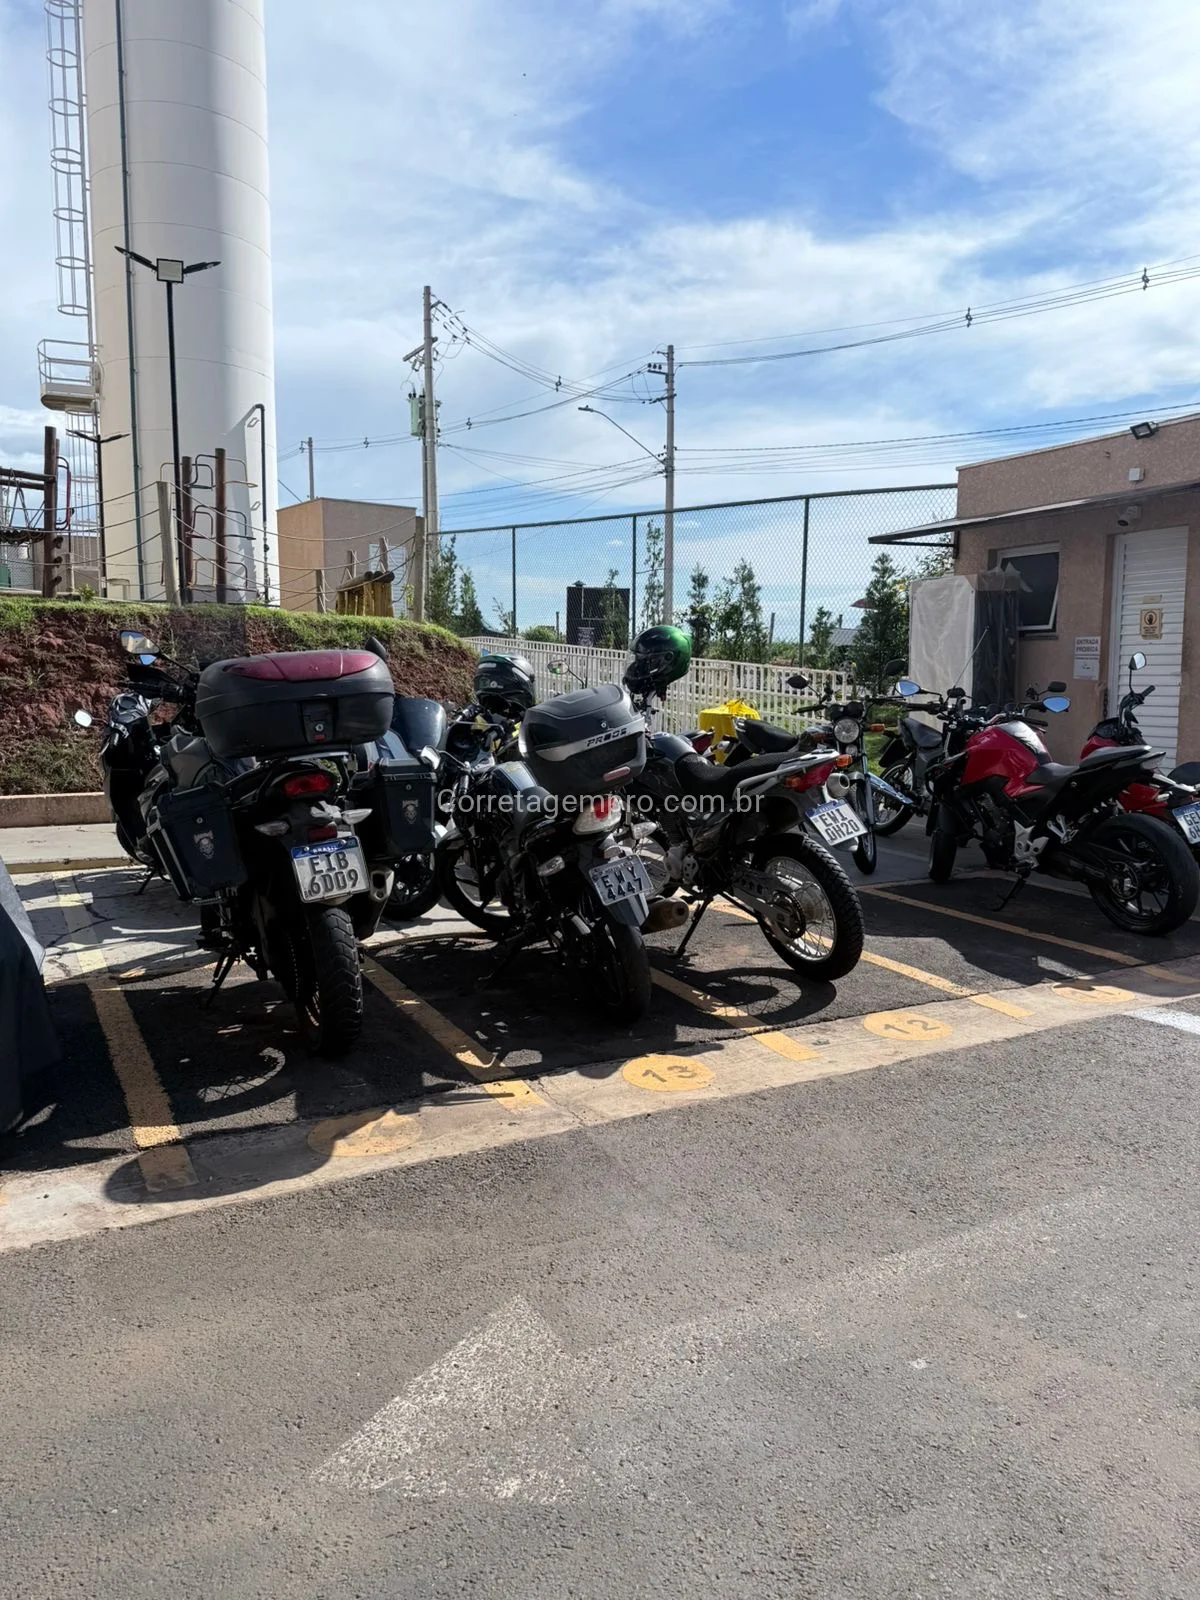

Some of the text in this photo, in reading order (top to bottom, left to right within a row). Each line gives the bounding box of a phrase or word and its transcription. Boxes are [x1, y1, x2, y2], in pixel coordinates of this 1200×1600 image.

[309, 851, 349, 875] EIB
[601, 866, 637, 888] EWY
[607, 877, 643, 901] 4447
[883, 1019, 941, 1035] 12
[641, 1064, 698, 1083] 13
